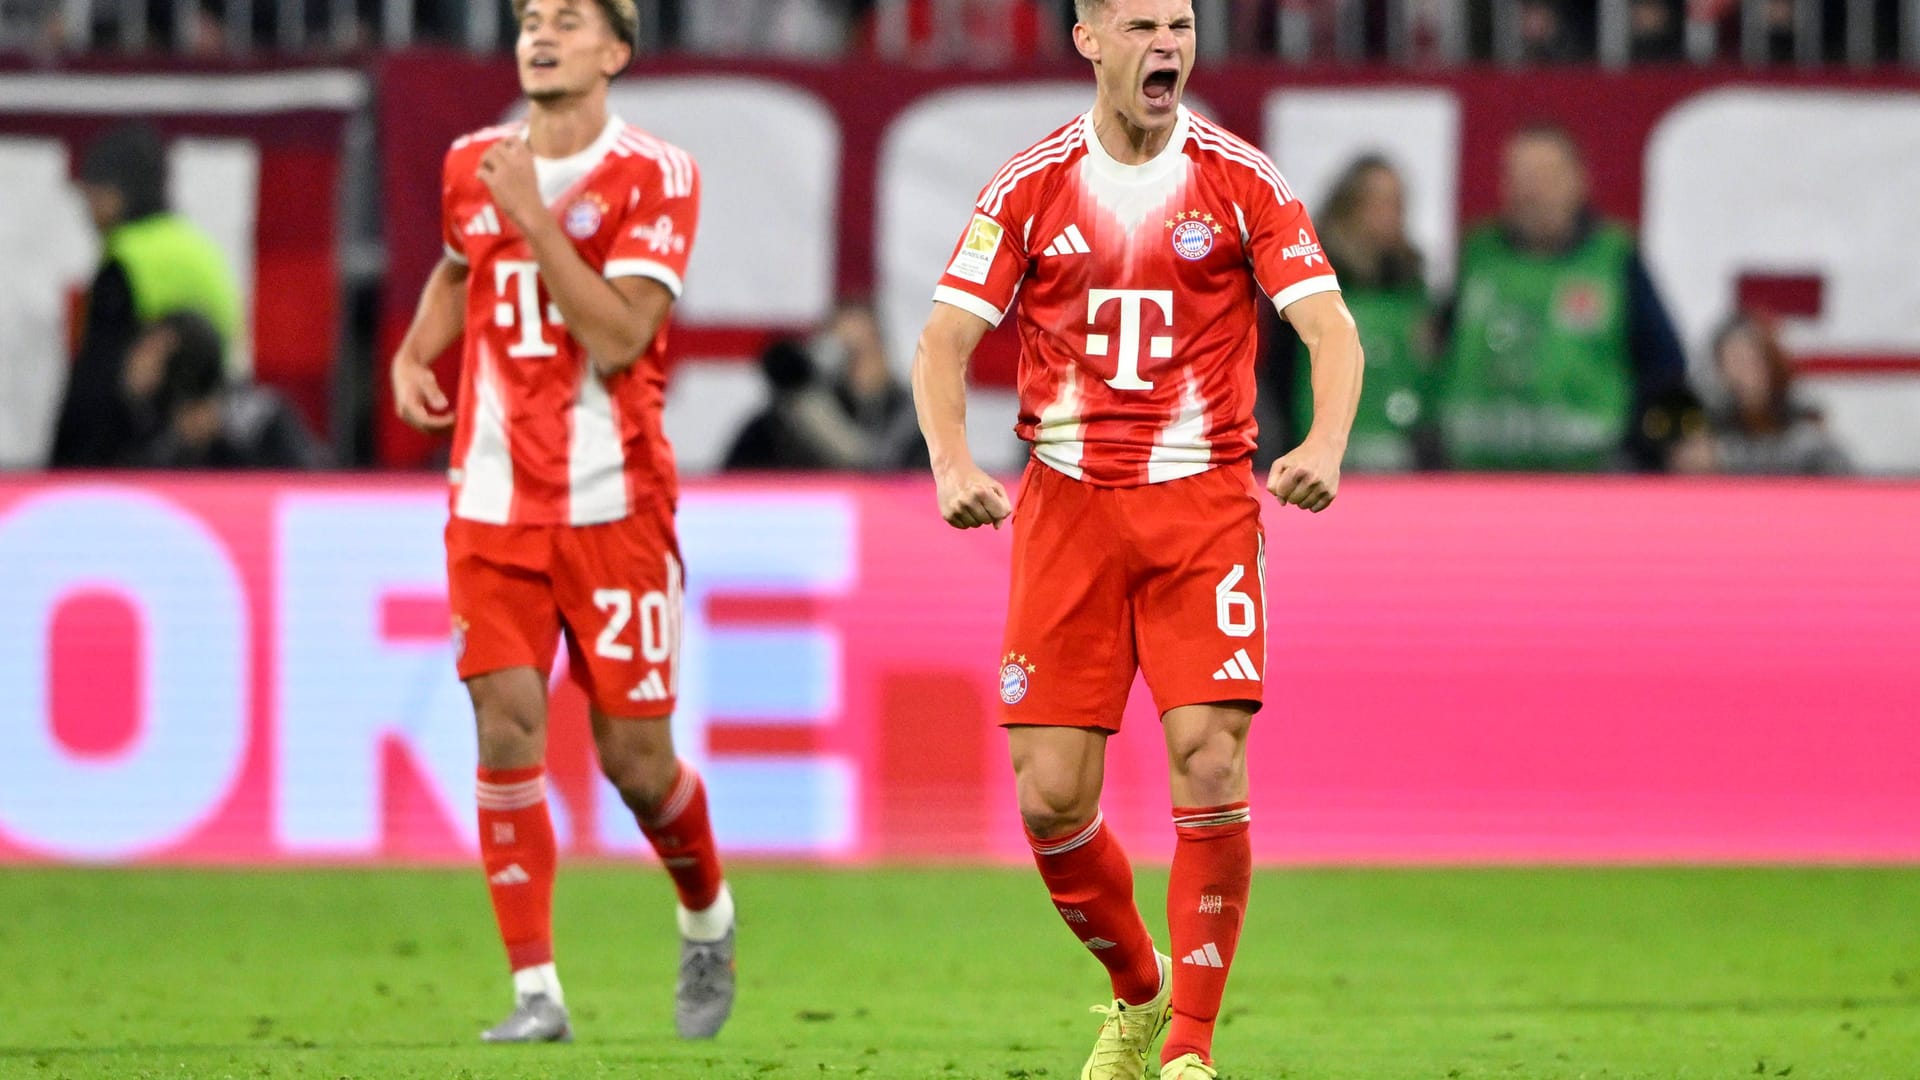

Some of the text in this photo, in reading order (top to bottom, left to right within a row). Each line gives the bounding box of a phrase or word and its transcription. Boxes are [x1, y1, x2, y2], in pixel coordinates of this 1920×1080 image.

[1185, 223, 1210, 239] BAYERN
[1281, 243, 1321, 261] Allianz
[494, 260, 565, 358] T
[1085, 288, 1173, 390] T
[594, 588, 669, 663] 20
[1215, 564, 1256, 637] 6
